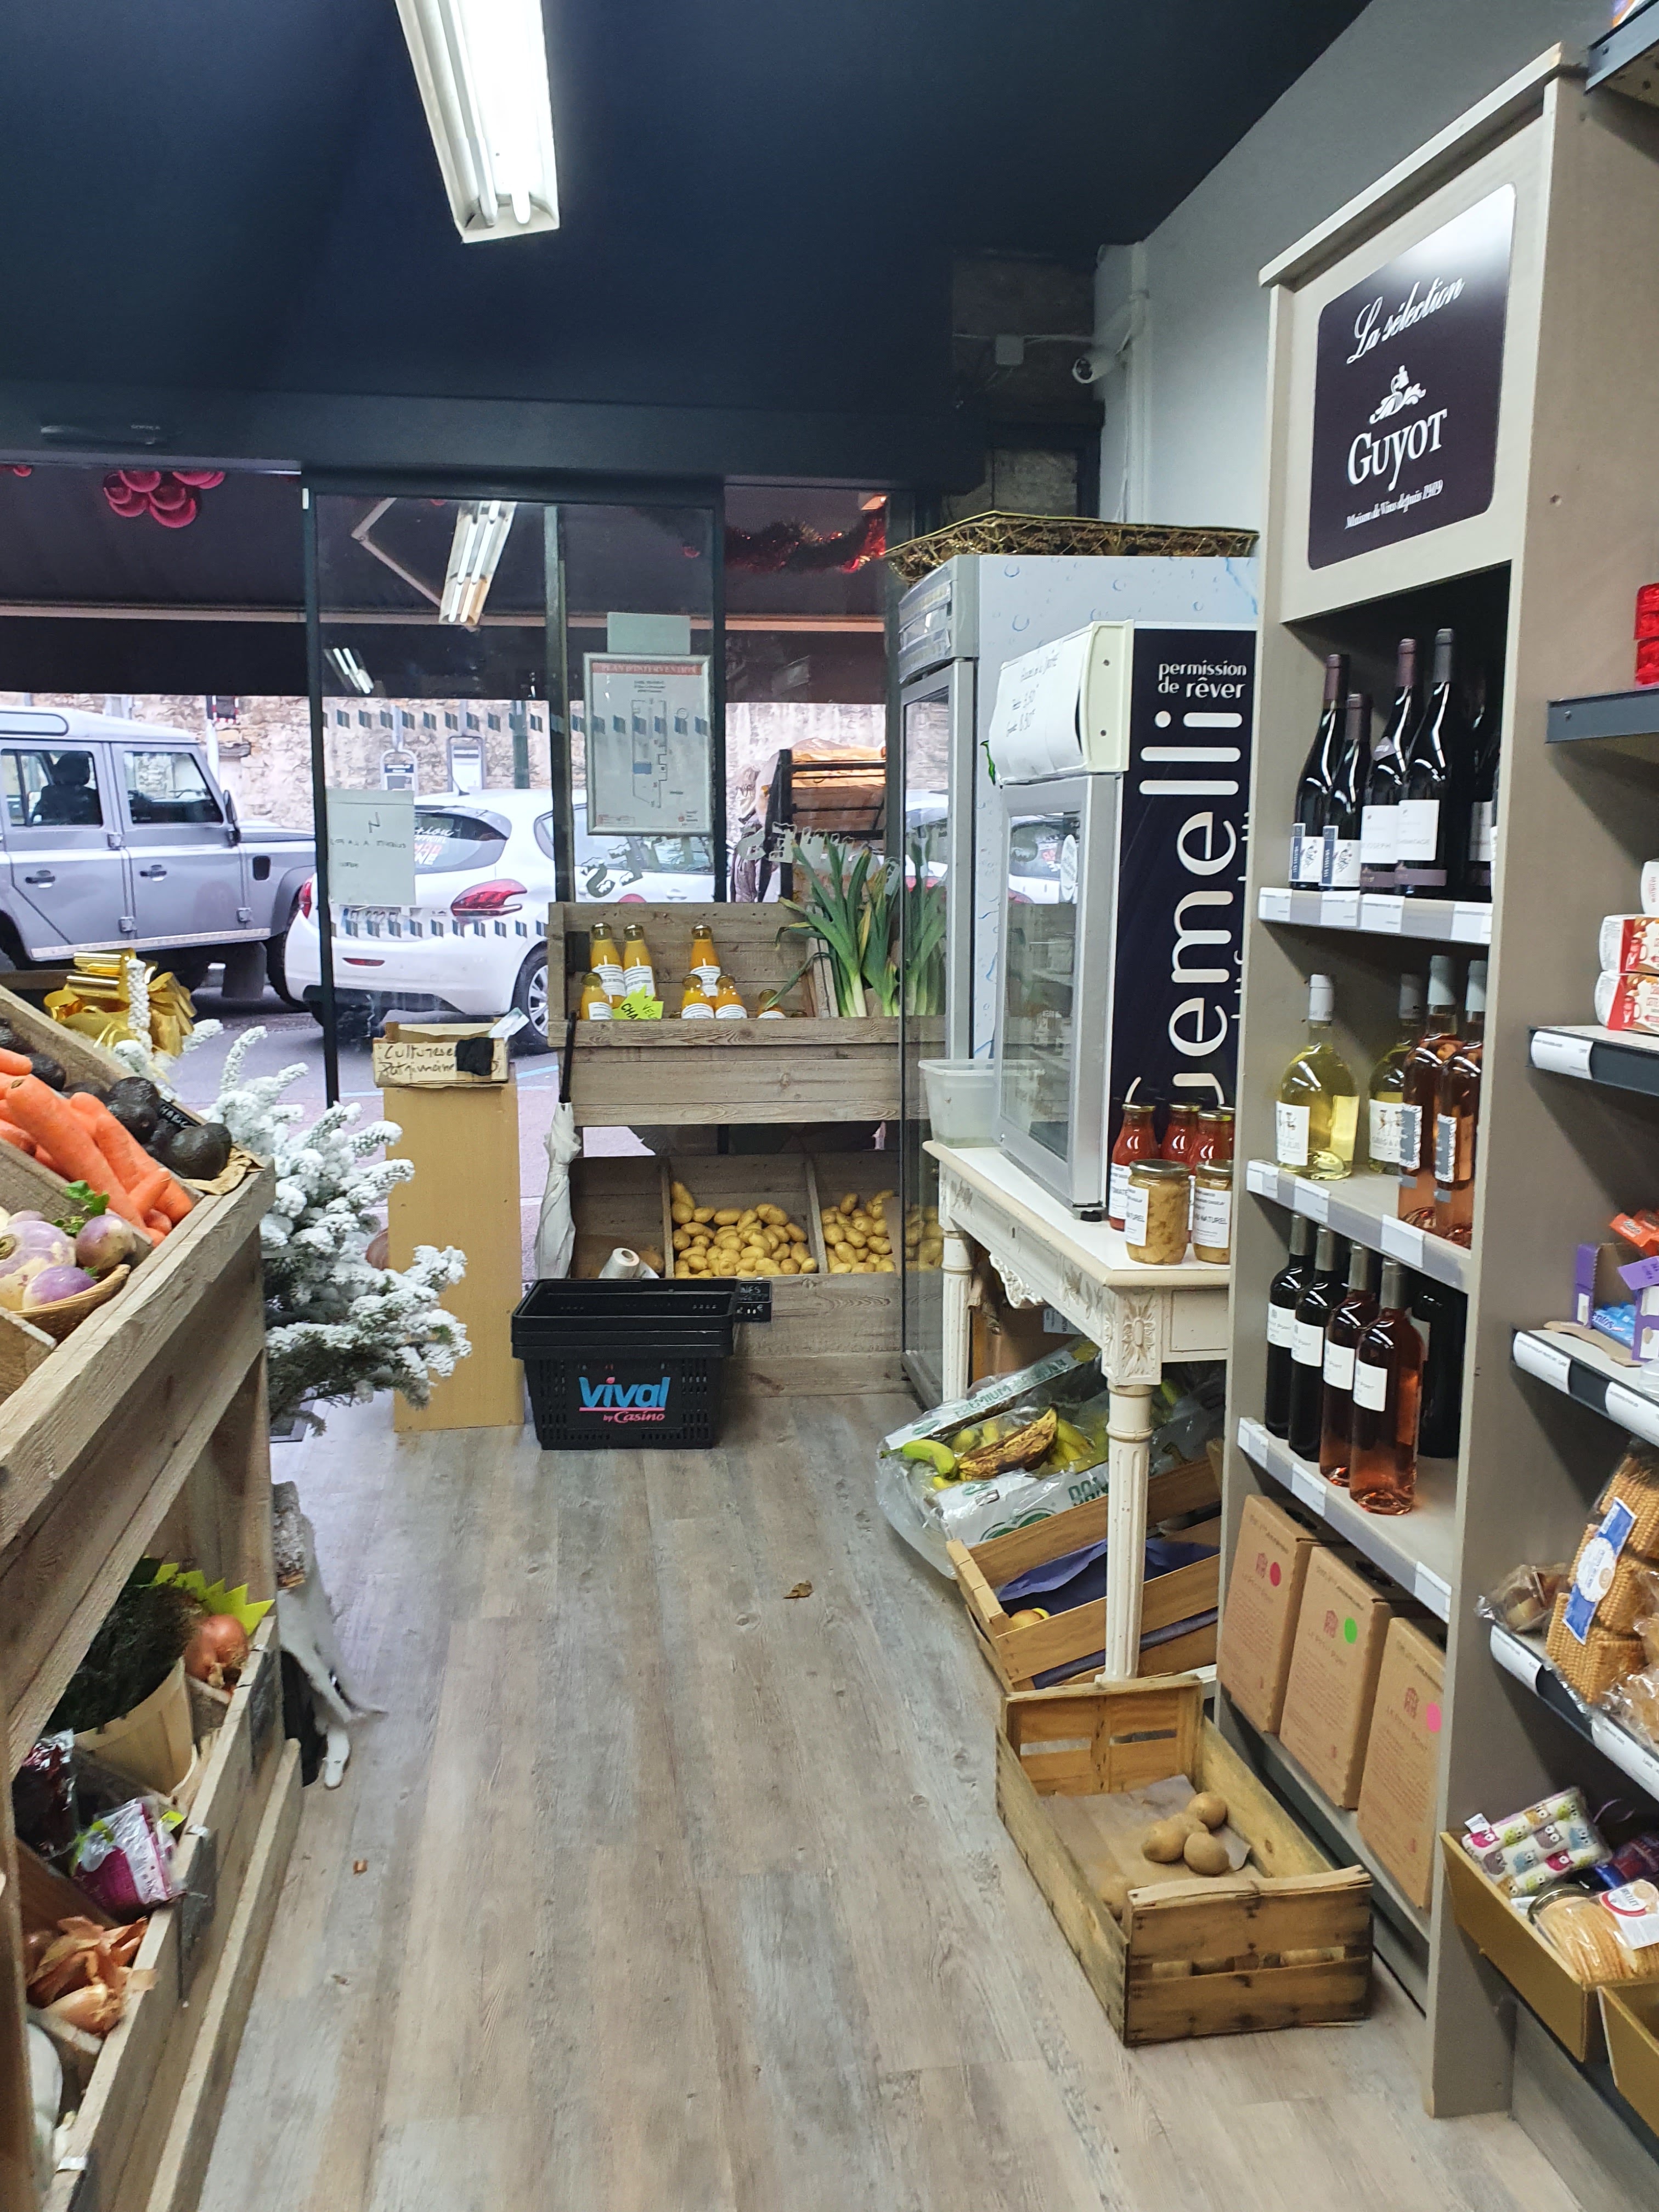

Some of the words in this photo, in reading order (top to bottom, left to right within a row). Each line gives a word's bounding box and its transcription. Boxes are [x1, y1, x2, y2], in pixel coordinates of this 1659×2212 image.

[1346, 296, 1383, 364] La
[1381, 276, 1465, 342] sélection
[1158, 660, 1247, 681] permission
[1158, 676, 1180, 693] de
[1186, 677, 1246, 698] rêver
[414, 826, 454, 837] tion
[621, 1003, 643, 1019] CHA
[1592, 1312, 1615, 1329] entos
[613, 1410, 665, 1423] Casino
